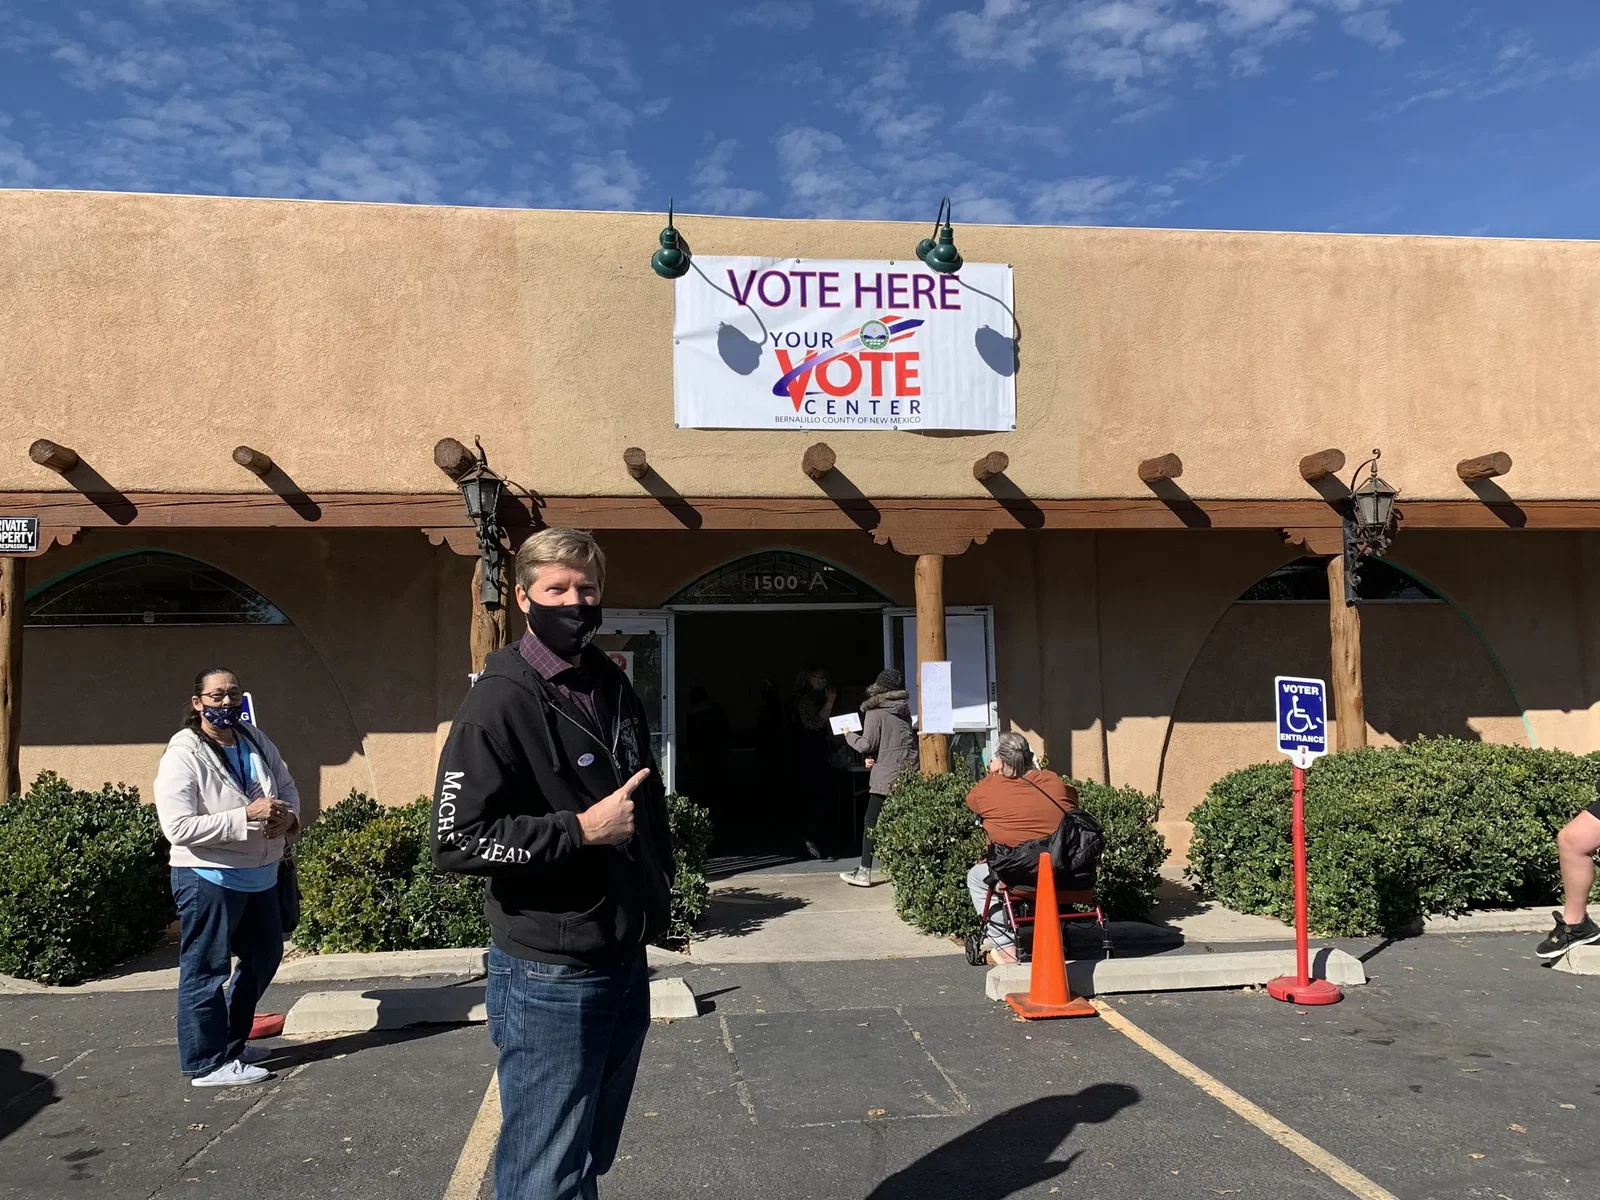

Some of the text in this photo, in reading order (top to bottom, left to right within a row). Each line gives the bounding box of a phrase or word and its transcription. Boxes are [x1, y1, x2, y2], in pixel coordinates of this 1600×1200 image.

[727, 269, 962, 311] VOTE HERE
[770, 331, 834, 349] YOUR
[774, 349, 921, 413] VOTE
[804, 399, 922, 415] CENTER
[775, 415, 922, 425] BERNALILLO COUNTY OF NEW MEXICO
[1283, 684, 1319, 695] VOTER
[1280, 733, 1324, 743] ENTRANCE
[472, 838, 531, 864] HEAD
